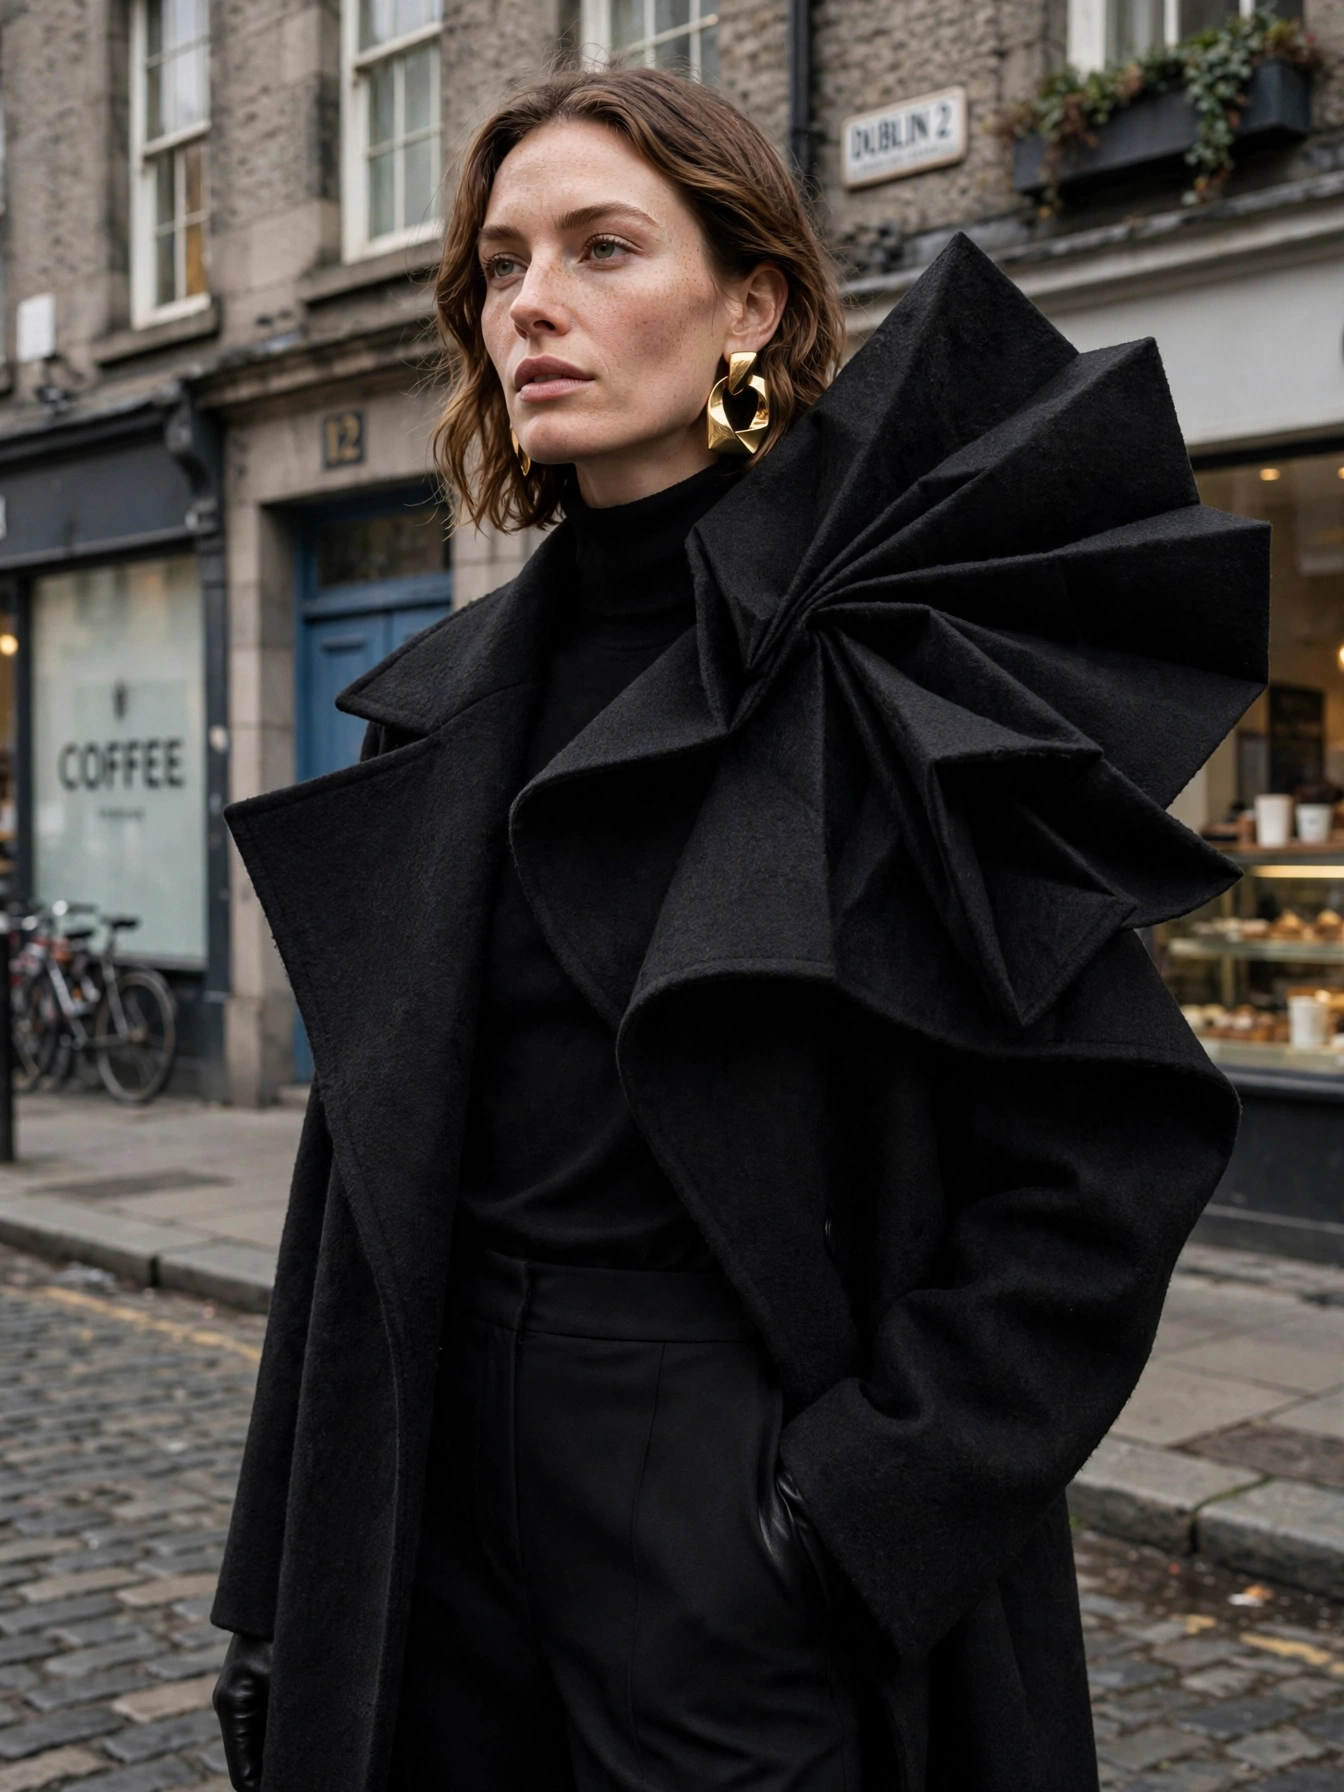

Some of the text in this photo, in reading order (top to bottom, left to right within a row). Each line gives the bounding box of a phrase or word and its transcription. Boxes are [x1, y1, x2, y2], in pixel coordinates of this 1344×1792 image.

[850, 111, 930, 160] DUBLIN
[935, 102, 952, 138] 2
[325, 415, 360, 463] 12
[57, 738, 184, 791] COFFEE
